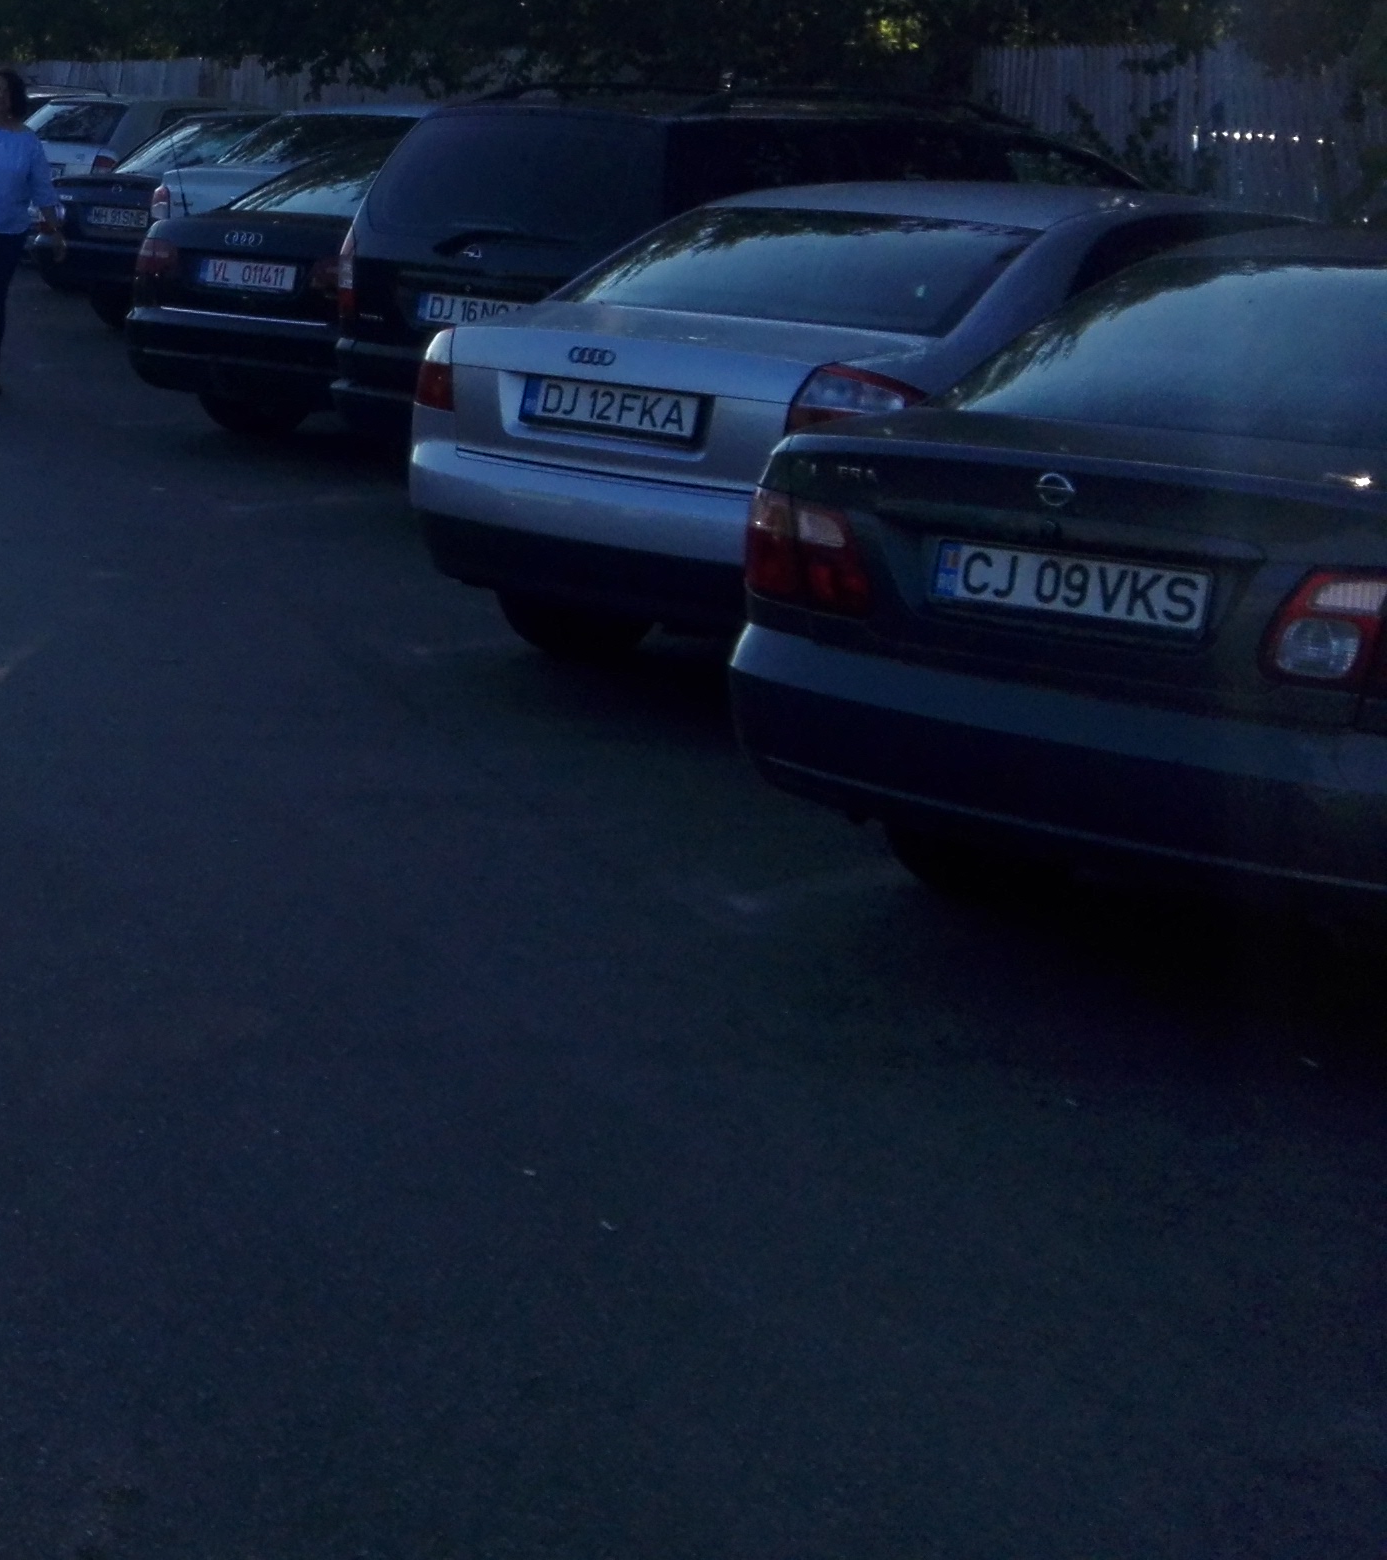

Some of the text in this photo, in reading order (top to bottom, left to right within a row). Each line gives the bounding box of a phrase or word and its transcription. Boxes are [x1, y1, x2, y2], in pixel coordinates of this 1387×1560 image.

[213, 261, 286, 287] VL 011411
[429, 296, 456, 320] DJ
[541, 383, 579, 416] DJ
[962, 551, 1019, 598] CJ
